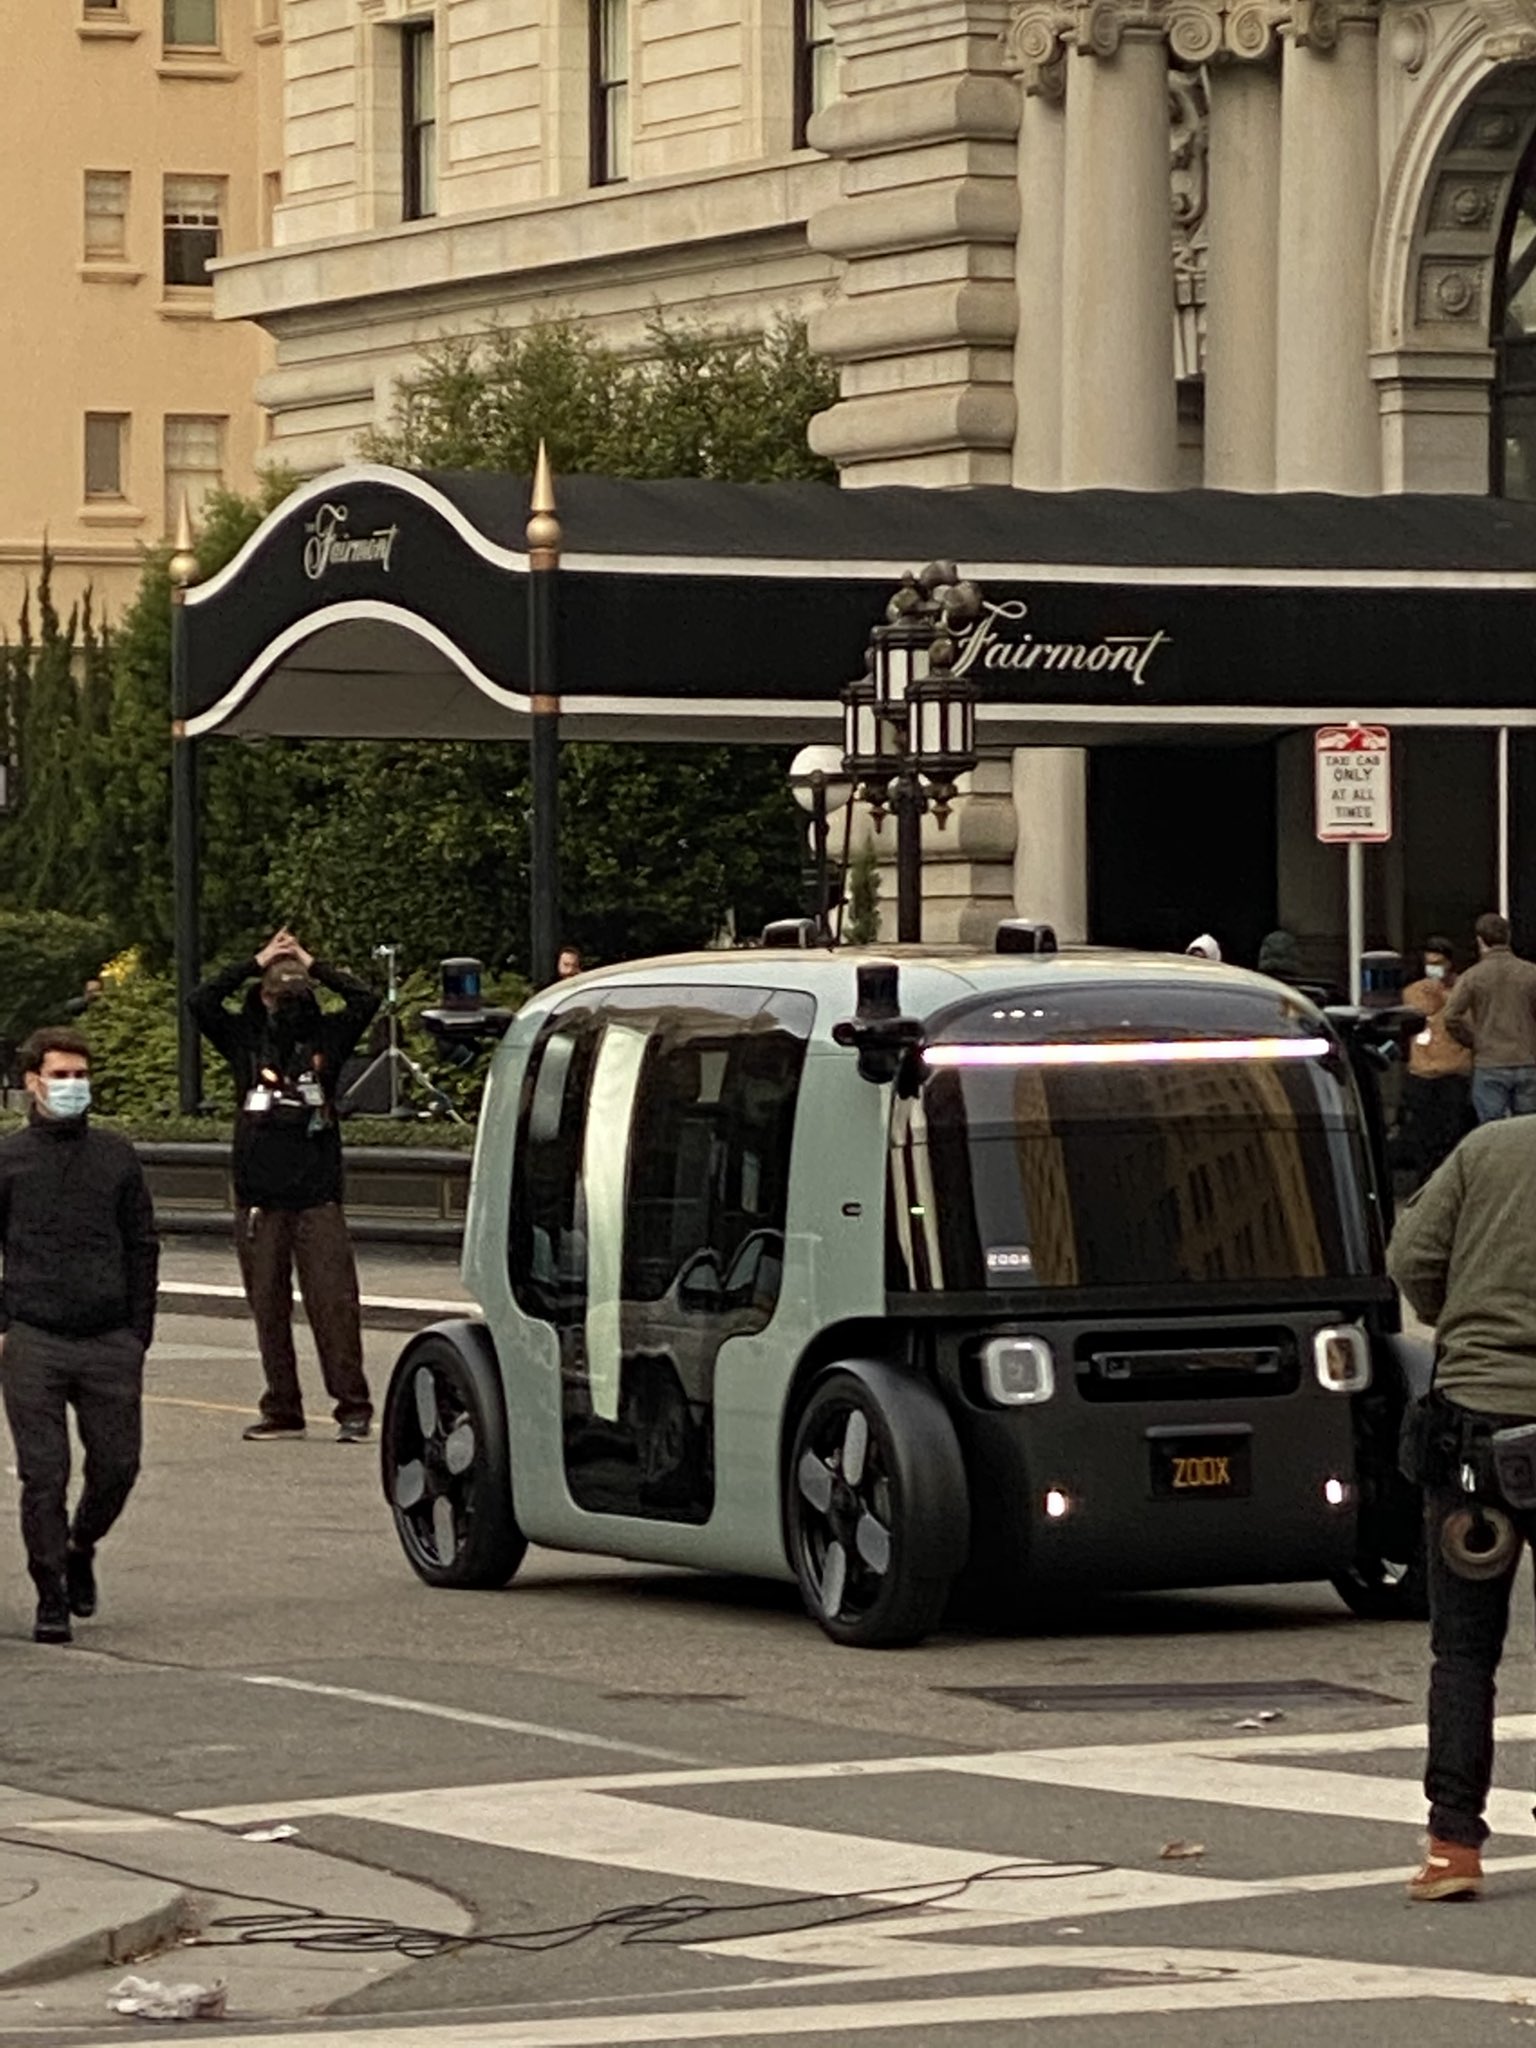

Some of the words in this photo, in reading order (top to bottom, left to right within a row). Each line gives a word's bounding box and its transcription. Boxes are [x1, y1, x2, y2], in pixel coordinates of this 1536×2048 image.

[304, 503, 398, 579] Fairmont
[940, 600, 1174, 685] Fairmont
[1333, 768, 1373, 782] ONLY
[1331, 788, 1347, 801] AT
[1353, 788, 1374, 801] ALL
[1335, 805, 1372, 818] TIMES
[1171, 1456, 1231, 1488] ZOOX
